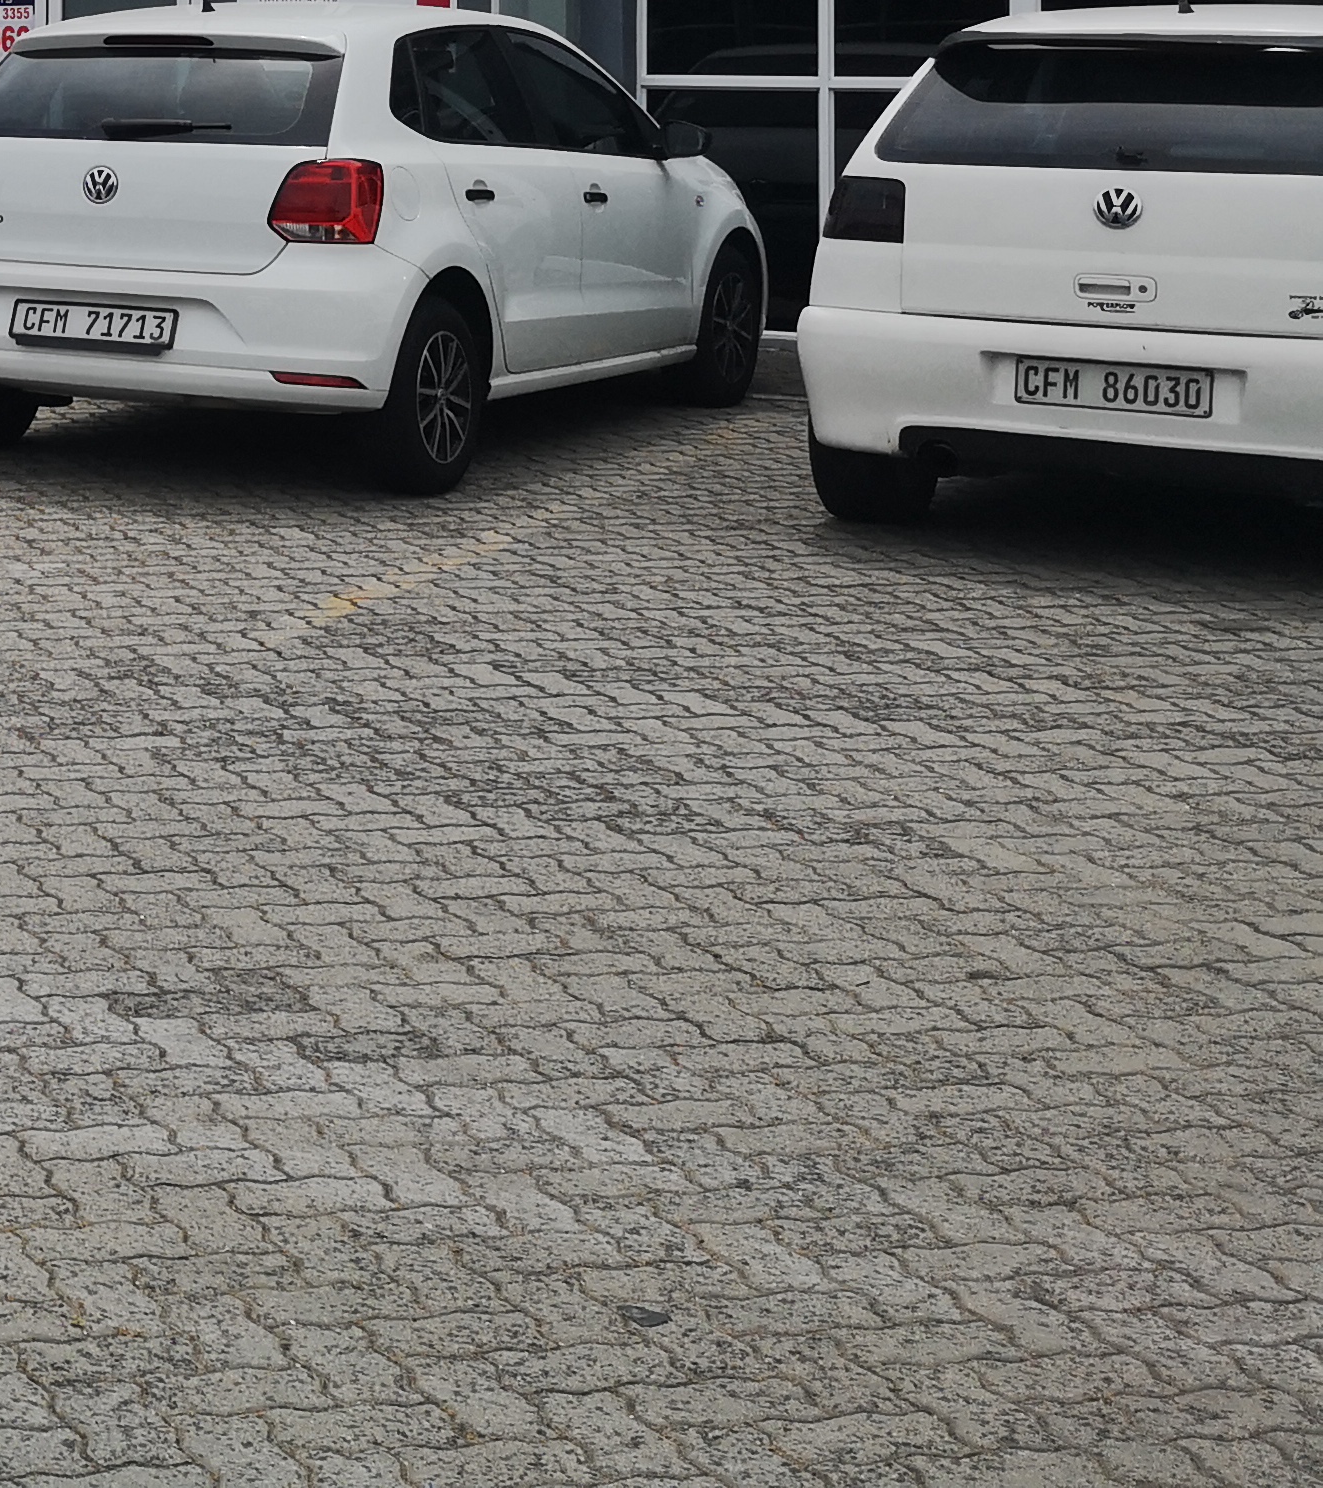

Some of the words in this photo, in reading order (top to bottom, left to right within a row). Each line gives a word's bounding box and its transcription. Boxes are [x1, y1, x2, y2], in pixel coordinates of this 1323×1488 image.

[2, 7, 30, 20] 3355
[22, 306, 70, 335] CFM
[85, 310, 168, 341] 71713
[1022, 365, 1080, 401] CFM
[1102, 371, 1202, 411] 86030
